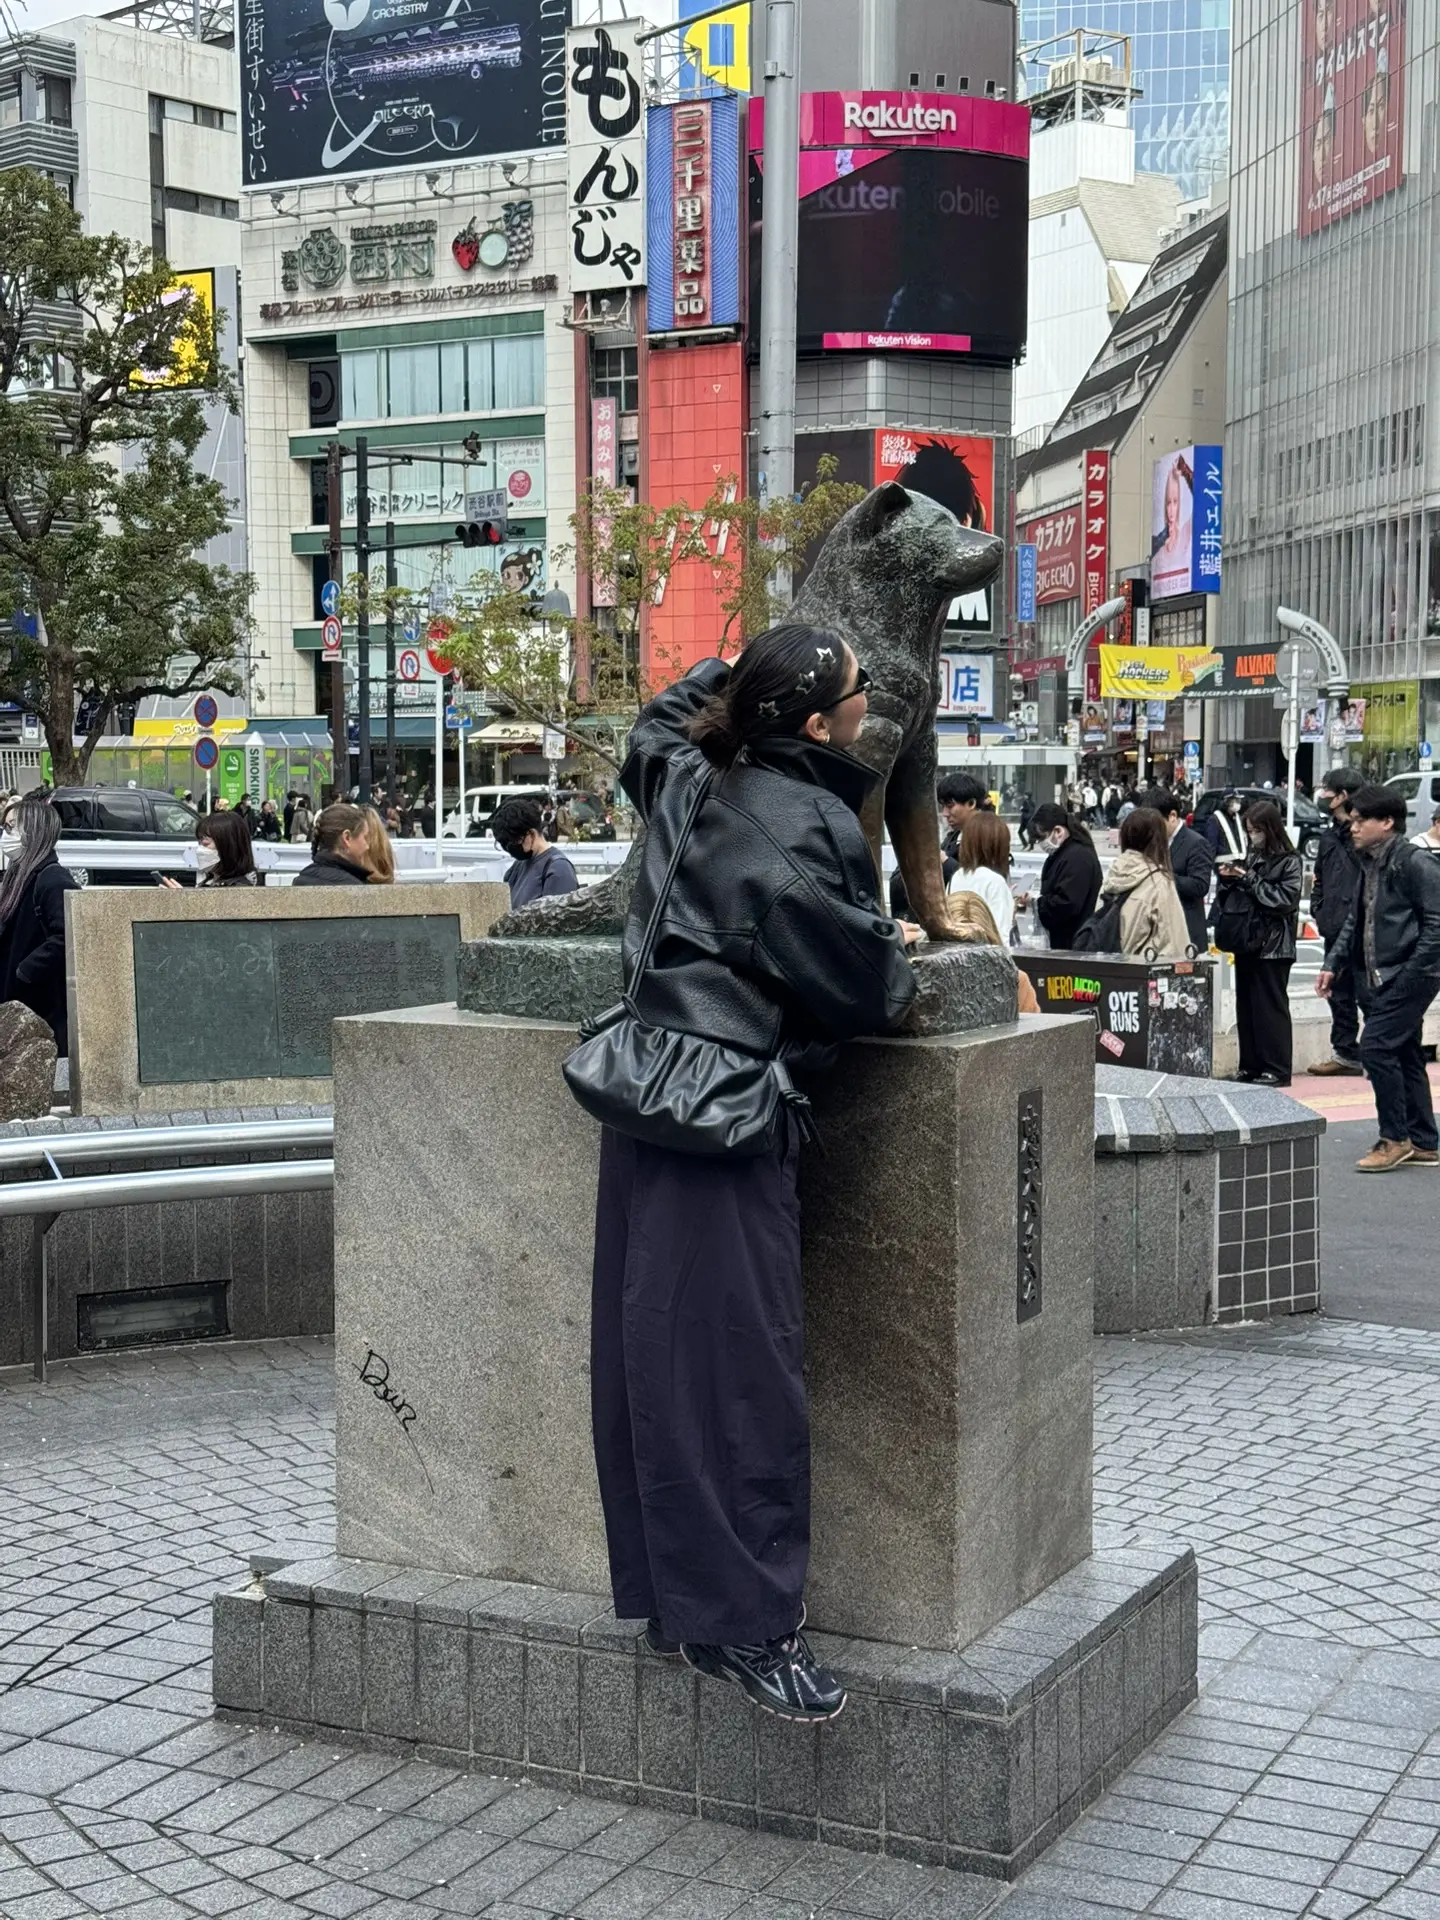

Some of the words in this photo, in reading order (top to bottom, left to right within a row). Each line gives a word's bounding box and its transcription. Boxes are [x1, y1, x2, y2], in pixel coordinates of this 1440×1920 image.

[540, 34, 567, 143] INOUE
[844, 101, 956, 134] Rakuten
[571, 28, 641, 281] もんじゃ
[674, 107, 705, 316] 三千里薬品
[868, 334, 904, 347] Rakuten
[904, 335, 931, 346] Vision
[1086, 463, 1106, 560] カラオケ
[1199, 461, 1223, 577] 藍井エイル
[1035, 514, 1077, 552] カラオケ
[1036, 569, 1050, 597] BIG
[1050, 561, 1076, 589] ECHO
[1088, 571, 1100, 597] BIG
[952, 665, 981, 702] 店
[249, 748, 260, 806] SMOKING
[1047, 976, 1073, 1000] NERO
[1073, 976, 1101, 1003] NERO
[1108, 991, 1139, 1012] OYE
[1109, 1011, 1140, 1033] RUNS
